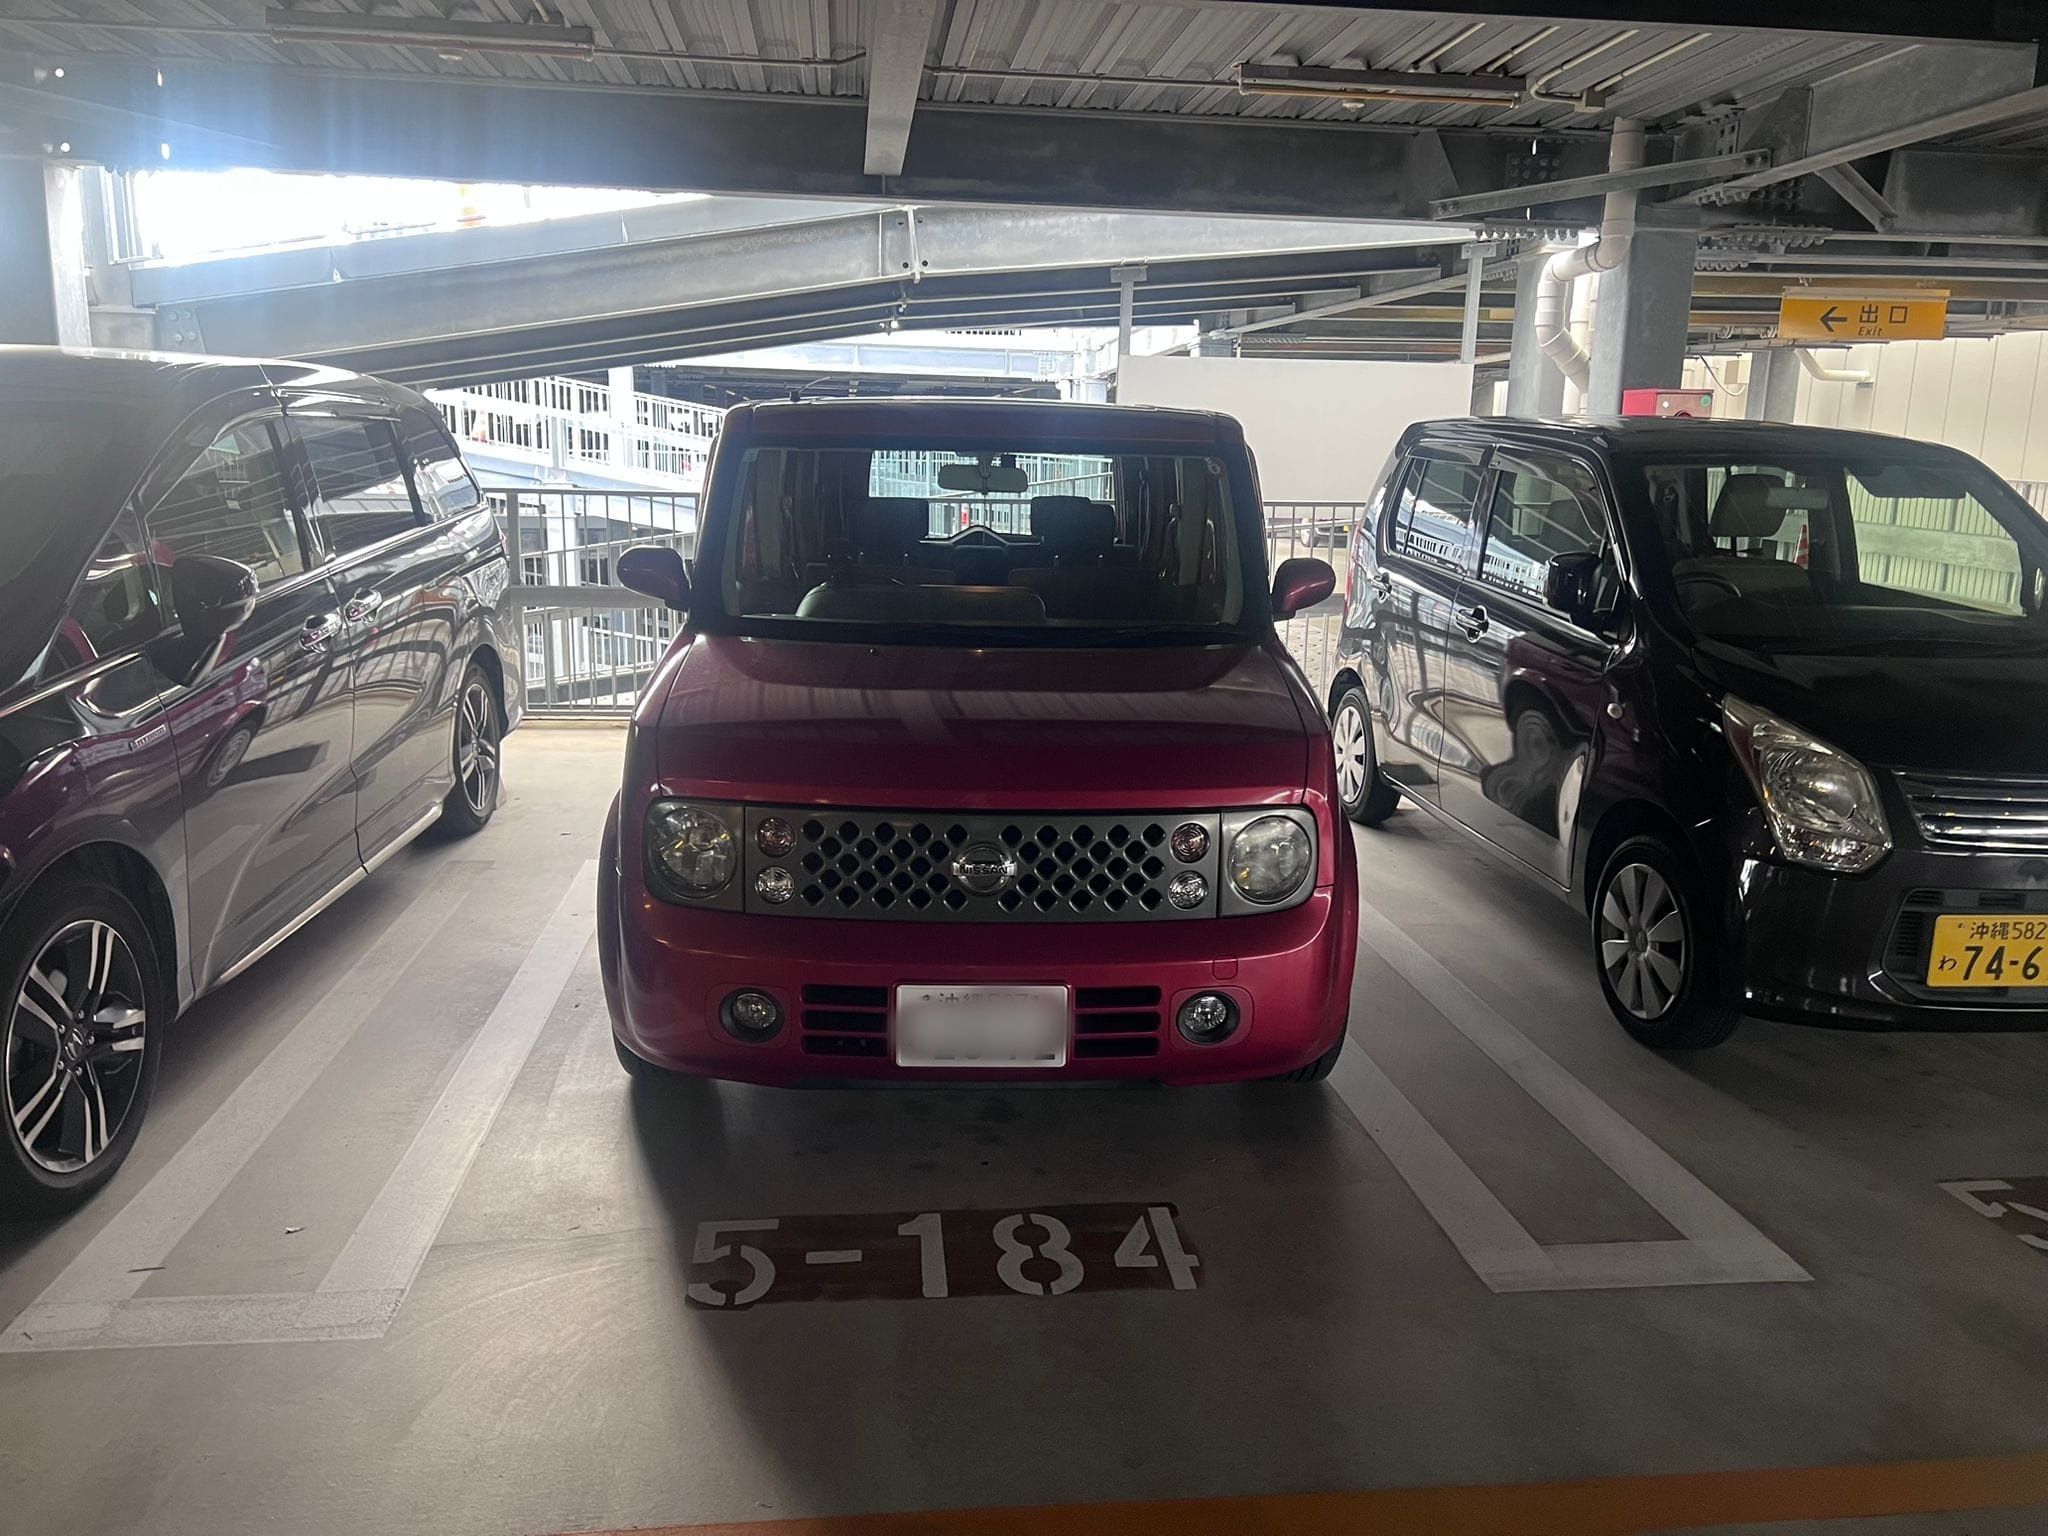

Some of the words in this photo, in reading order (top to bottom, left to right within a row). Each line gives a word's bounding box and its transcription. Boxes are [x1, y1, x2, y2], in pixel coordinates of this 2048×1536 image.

[1859, 304, 1909, 324] 出口
[1857, 326, 1883, 337] Exit
[960, 864, 1008, 875] NISSAN
[1938, 955, 1958, 972] わ
[1962, 945, 2048, 981] 74-6
[687, 1206, 1200, 1307] 5-184
